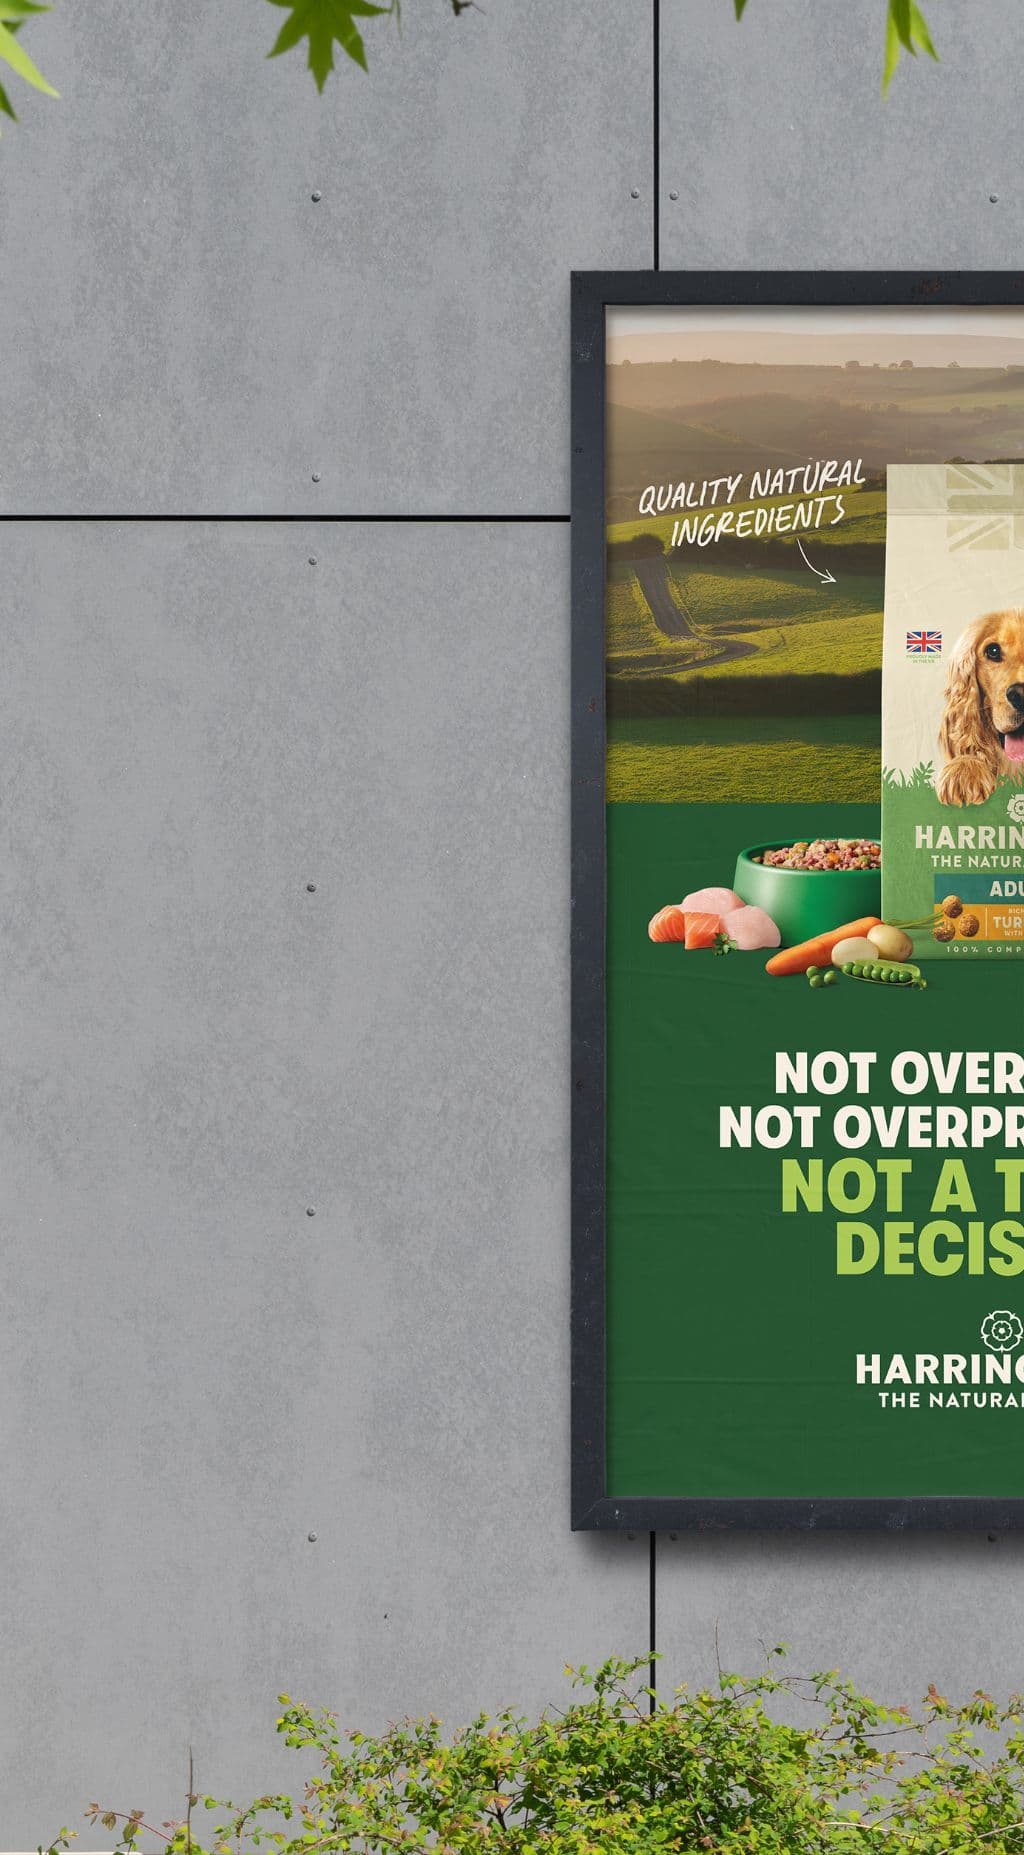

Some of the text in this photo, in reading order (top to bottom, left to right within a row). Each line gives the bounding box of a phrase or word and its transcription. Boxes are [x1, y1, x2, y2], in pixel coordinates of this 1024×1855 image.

[638, 458, 867, 516] QUALITY NATURAL
[670, 495, 846, 547] INGREDIENTS
[931, 855, 962, 868] THE
[774, 1051, 876, 1095] NOT
[719, 1105, 822, 1149] NOT
[781, 1157, 912, 1215] NOT
[930, 1158, 978, 1213] A
[878, 1392, 924, 1409] THE
